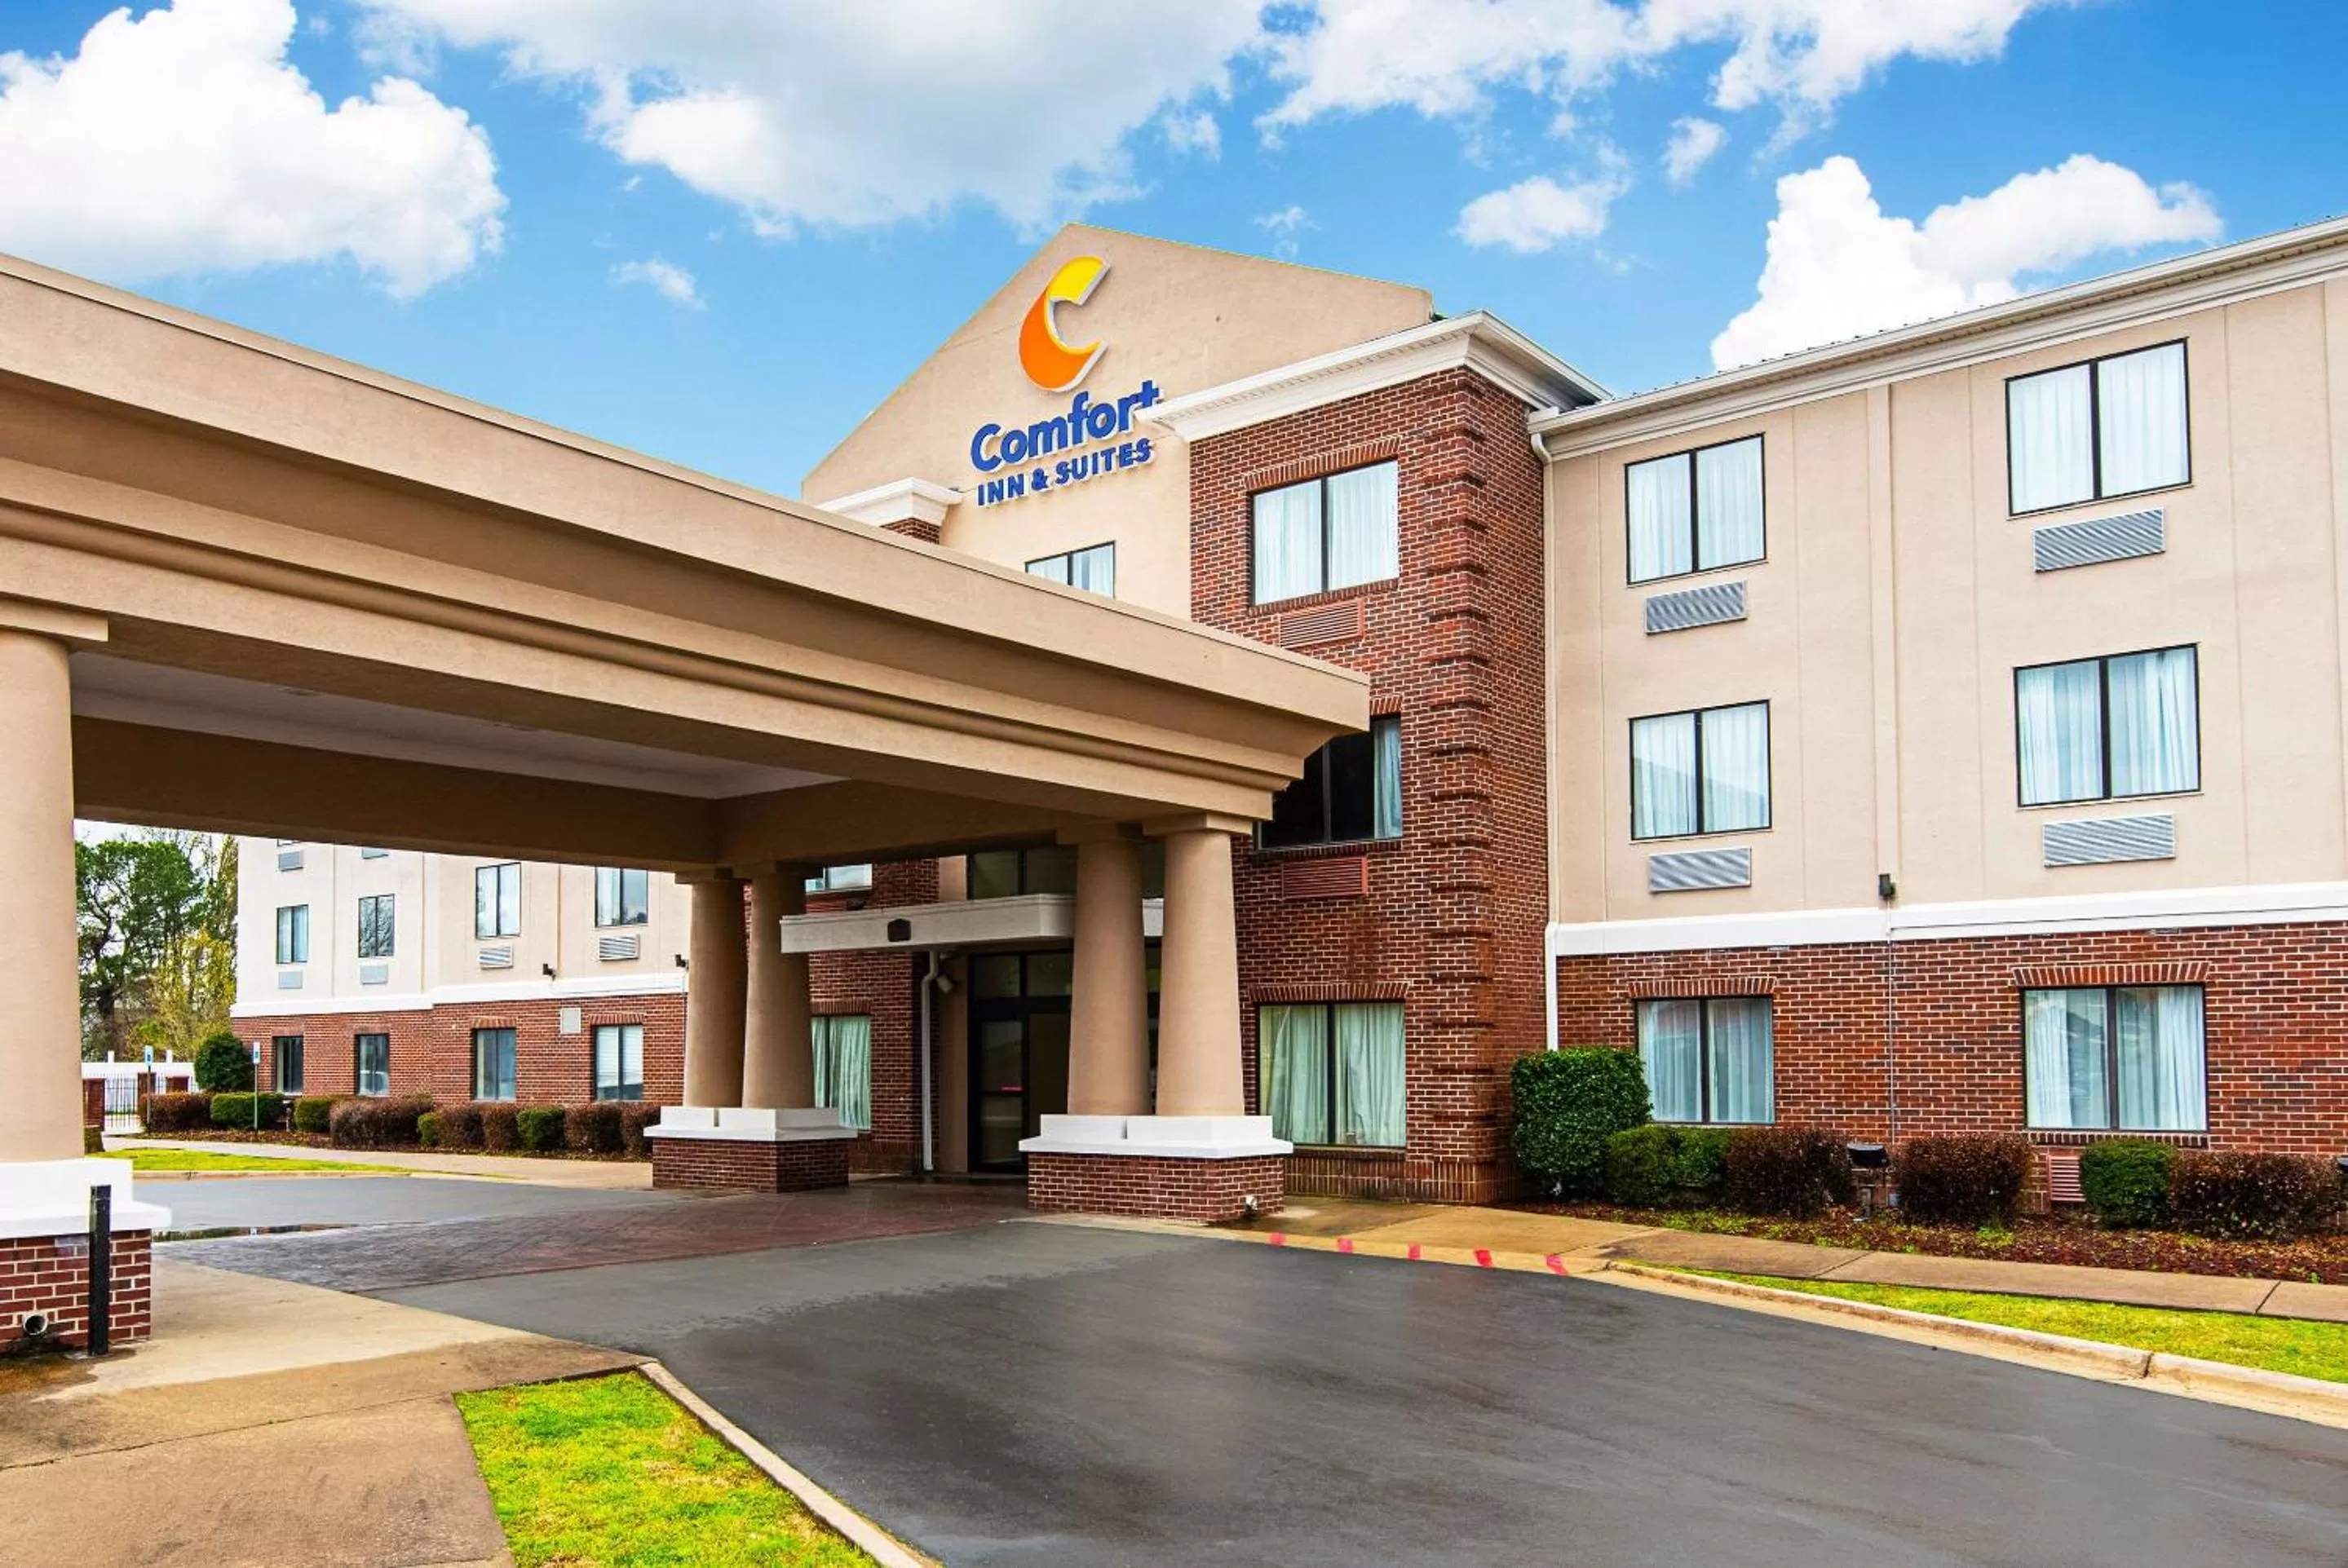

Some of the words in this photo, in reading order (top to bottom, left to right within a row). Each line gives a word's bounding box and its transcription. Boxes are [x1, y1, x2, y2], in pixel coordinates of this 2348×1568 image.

[971, 380, 1160, 472] Comfort
[978, 473, 1024, 506] INN
[1032, 467, 1049, 490] &
[1055, 438, 1152, 484] SUITES
